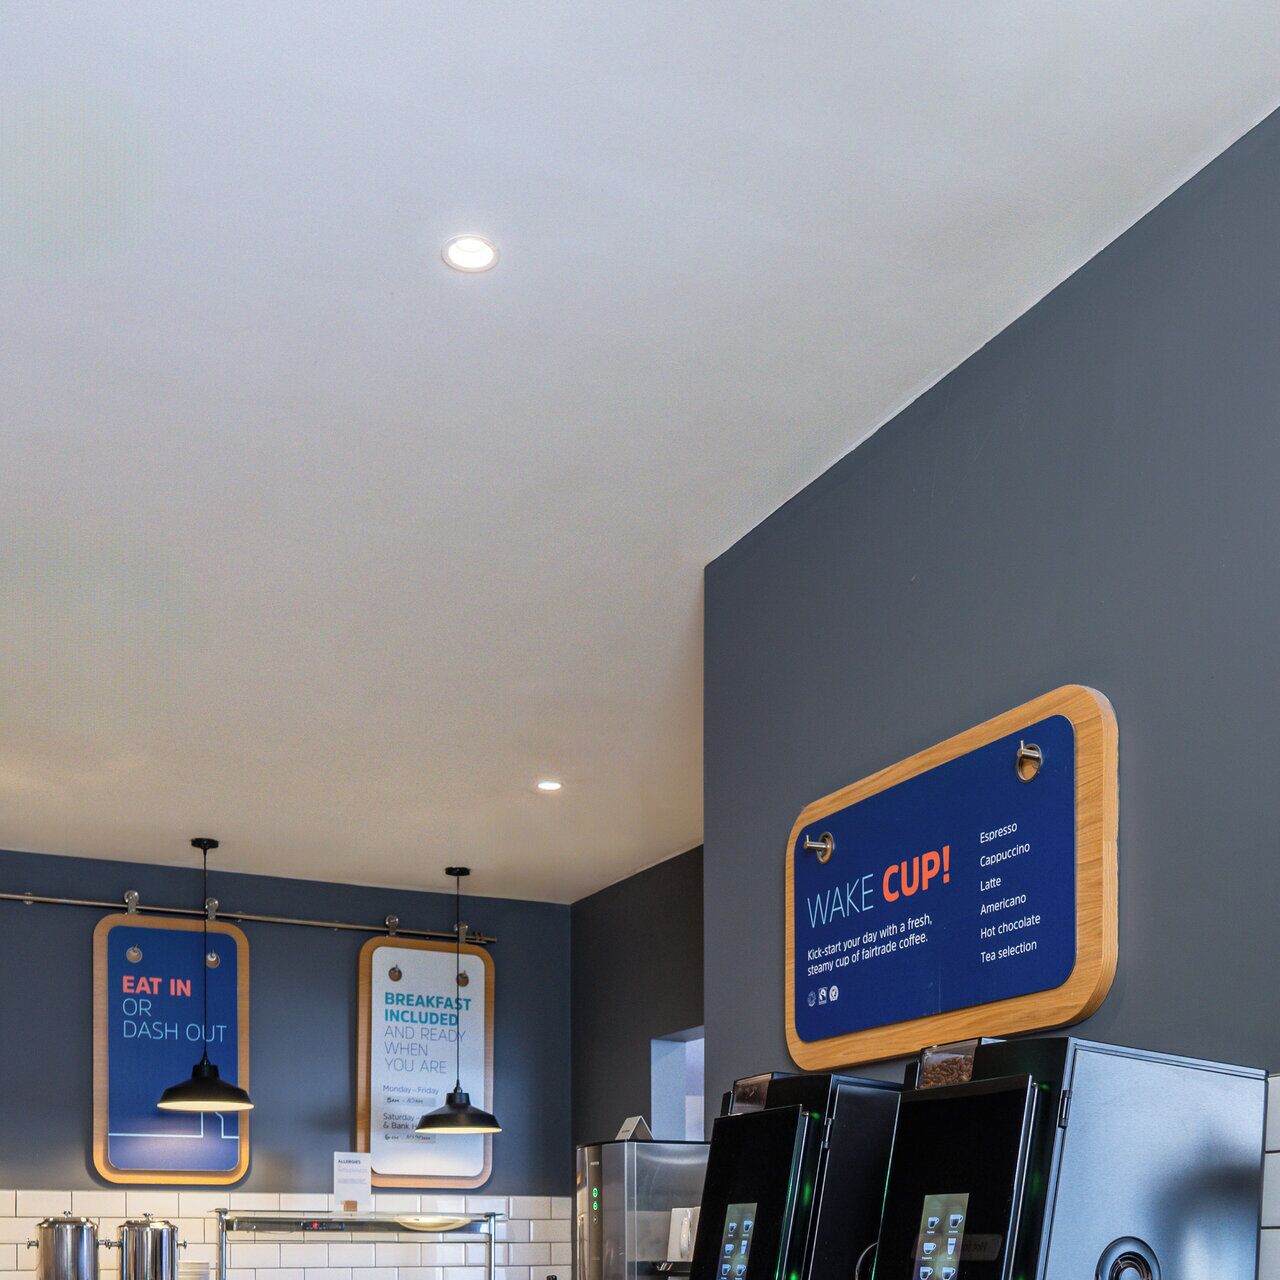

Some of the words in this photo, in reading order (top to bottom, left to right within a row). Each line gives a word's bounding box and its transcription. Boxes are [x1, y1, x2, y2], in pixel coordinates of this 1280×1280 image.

[980, 822, 1018, 844] Espresso
[980, 842, 1031, 867] Cappuccino
[807, 873, 874, 929] WAKE
[882, 844, 950, 903] CUP!
[980, 876, 1002, 892] Latte
[980, 893, 1027, 915] Americano
[807, 941, 842, 961] Kick-start
[842, 935, 861, 952] your
[862, 930, 878, 945] day
[879, 923, 898, 939] with
[899, 922, 906, 933] a
[907, 912, 933, 931] fresh,
[980, 925, 996, 939] Hot
[997, 913, 1041, 935] chocolate
[807, 959, 834, 977] steamy
[835, 954, 850, 968] cup
[851, 950, 861, 963] of
[861, 940, 897, 960] fairtrade
[898, 932, 929, 949] coffee.
[980, 951, 996, 963] Tea
[997, 940, 1037, 959] selection
[122, 975, 162, 996] EAT
[169, 978, 192, 997] IN
[122, 997, 152, 1017] OR
[384, 992, 472, 1011] BREAKFAST
[384, 1009, 458, 1026] INCLUDED
[122, 1020, 178, 1041] DASH
[185, 1023, 227, 1044] OUT
[384, 1025, 415, 1040] AND
[420, 1027, 466, 1043] READY
[384, 1041, 428, 1057] WHEN
[384, 1057, 414, 1072] YOU
[419, 1059, 448, 1074] ARE
[383, 1085, 411, 1094] Monday
[417, 1086, 439, 1095] Friday
[383, 1112, 415, 1121] Saturday
[391, 1121, 410, 1129] Bank
